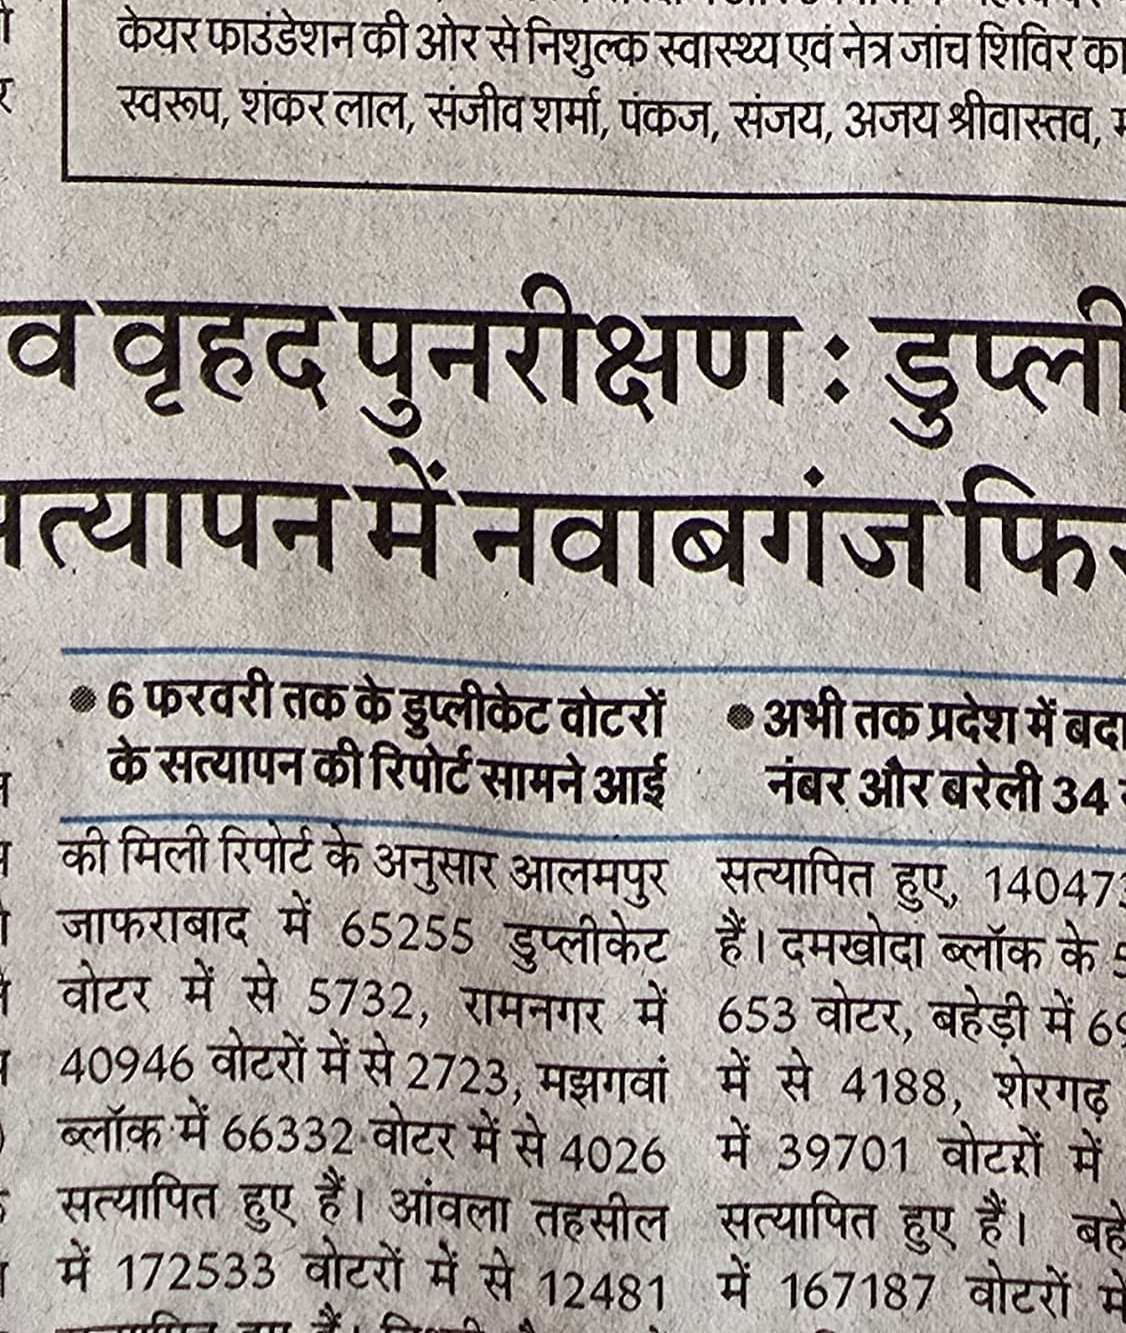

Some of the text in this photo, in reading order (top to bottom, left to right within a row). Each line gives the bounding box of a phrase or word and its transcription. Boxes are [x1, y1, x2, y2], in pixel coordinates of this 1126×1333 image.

[116, 85, 229, 130] स्वरूप,
[239, 81, 329, 128] शंकर
[333, 91, 415, 134] लाल,
[424, 81, 526, 135] संजीव
[532, 85, 609, 141] शर्मा,
[618, 91, 719, 143] पंकज,
[729, 93, 832, 144] संजय,
[845, 101, 940, 139] अजय
[948, 89, 1101, 149] श्रीवास्तव,
[96, 300, 337, 417] वृहद
[338, 272, 804, 438] पुनरीक्षण
[353, 447, 455, 580] में
[458, 466, 944, 589] नवाबगंज
[108, 667, 667, 738] 6 फरवरी तक के डुप्लीकेट वोटरों
[764, 685, 847, 739] अभी
[852, 700, 923, 740] तक
[927, 691, 1019, 744] प्रदेश
[1025, 695, 1057, 747] में
[107, 735, 667, 809] के सत्यापन की रिपोर्ट सामने आई
[765, 756, 851, 805] नंबर
[859, 755, 934, 808] और
[939, 758, 1043, 813] बरेली
[1053, 776, 1109, 816] 34
[716, 846, 875, 897] सत्यापित
[891, 863, 958, 913] हुए,
[55, 892, 670, 970] जाफराबाद में 65255 डुप्लीकेट
